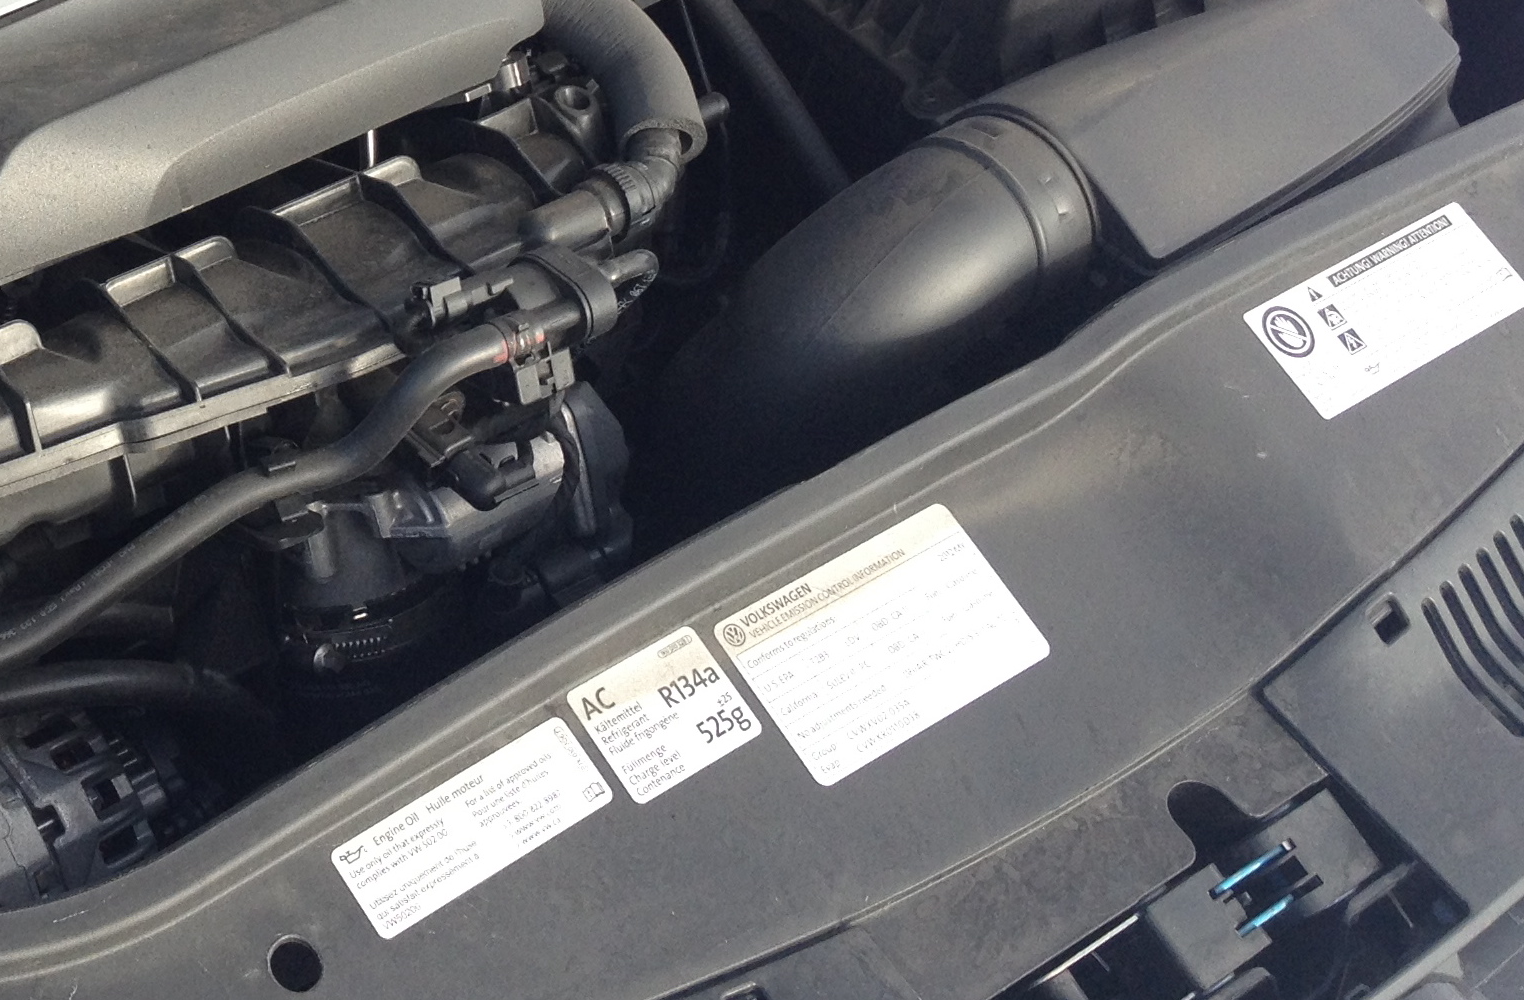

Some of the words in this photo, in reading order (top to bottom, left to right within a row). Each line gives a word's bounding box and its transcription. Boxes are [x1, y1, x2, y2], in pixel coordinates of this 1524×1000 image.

[1331, 257, 1373, 285] ACHTUNG!
[1368, 237, 1410, 264] WARNING!
[1407, 216, 1449, 244] ATTENTION!
[739, 582, 812, 627] VOLKSWAGEN
[747, 615, 783, 638] VEHICLE
[779, 596, 819, 622] EMISSION
[816, 577, 854, 602] CONTROL
[851, 548, 905, 582] INFORMATION
[746, 644, 785, 669] Conforms
[782, 639, 794, 649] to
[581, 686, 616, 721] AC
[593, 700, 643, 733] Kältemittel
[657, 666, 720, 708] R134a
[600, 713, 650, 744] Refrigerant
[607, 737, 635, 755] Fluide
[620, 744, 667, 774] Füllmenge
[695, 706, 751, 743] 525g
[628, 763, 660, 786] Charge
[659, 749, 680, 766] level
[635, 763, 686, 796] Contenance
[371, 822, 405, 846] Engine
[403, 811, 420, 826] Oil
[424, 794, 451, 814] Huile
[450, 774, 484, 799] moteur
[463, 796, 477, 808] For
[391, 838, 410, 852] that
[409, 817, 444, 842] expressly
